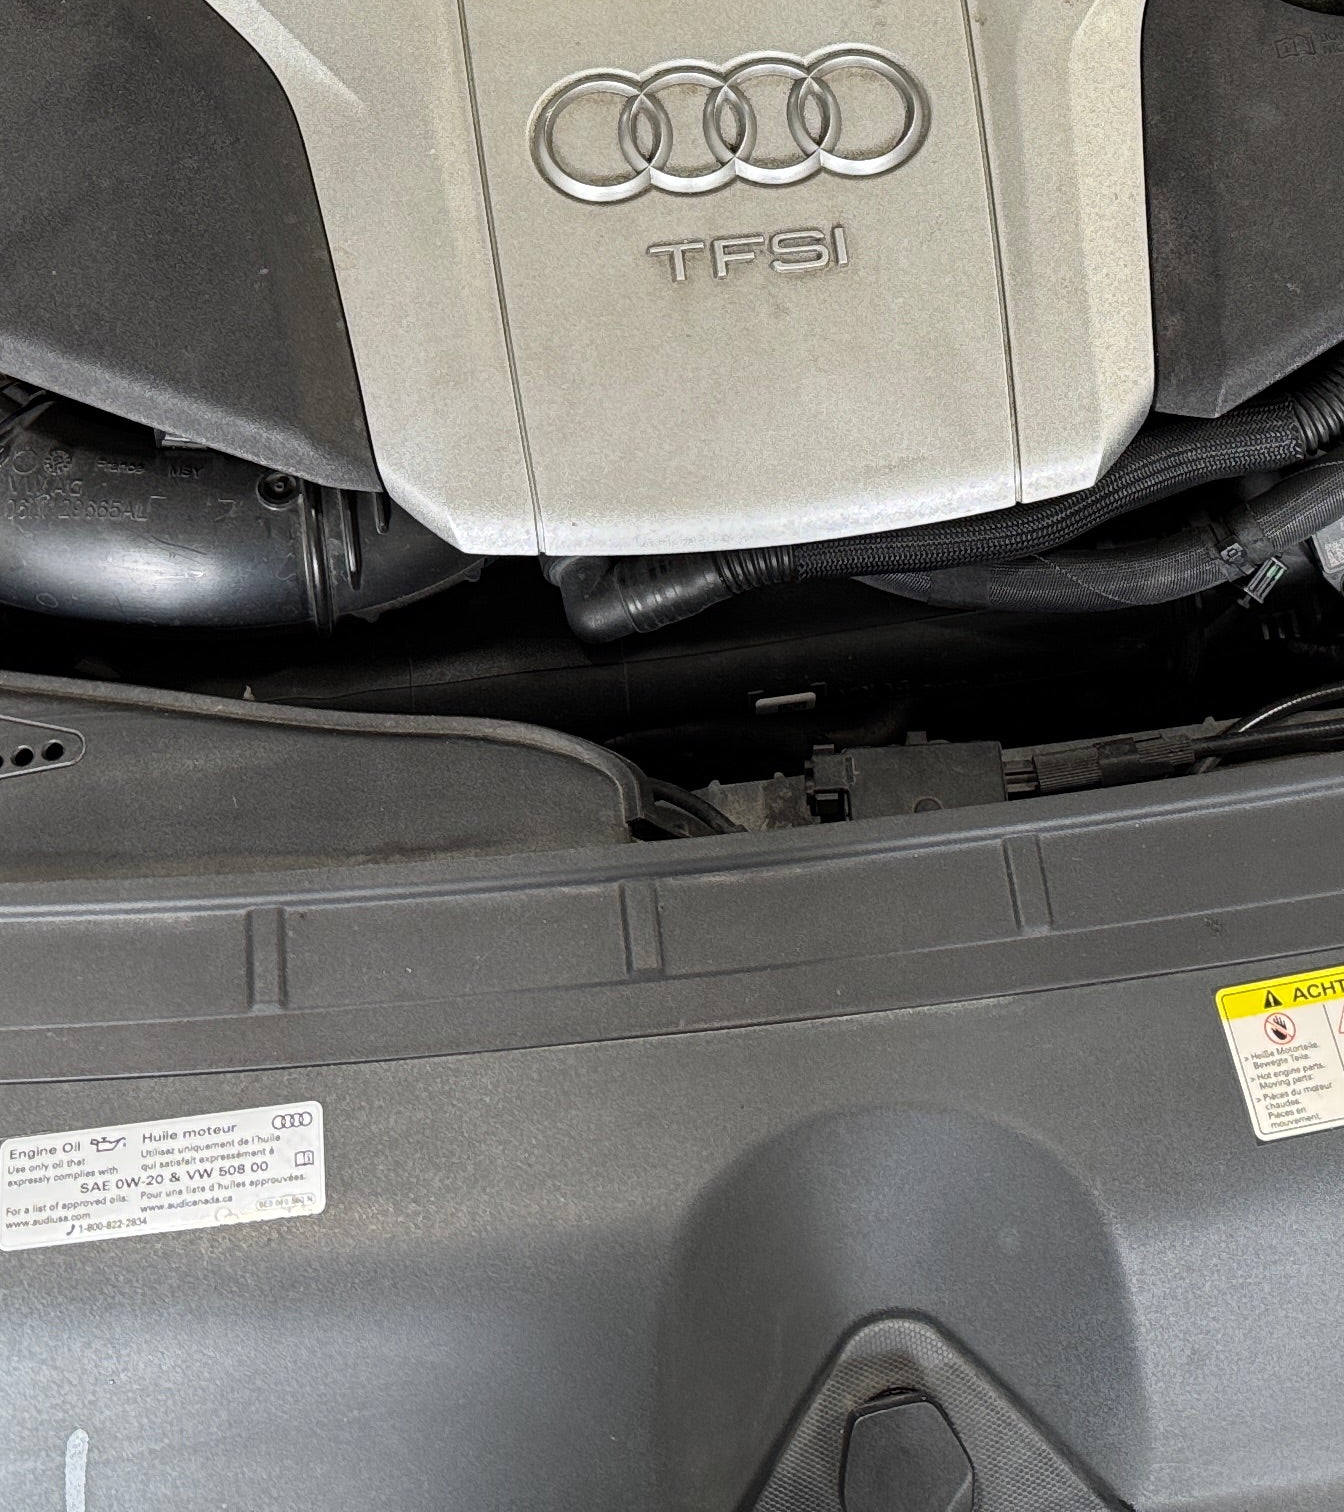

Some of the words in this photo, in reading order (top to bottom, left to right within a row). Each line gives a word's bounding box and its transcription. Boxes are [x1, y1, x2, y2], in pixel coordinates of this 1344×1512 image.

[647, 225, 852, 283] TFSI
[142, 1129, 177, 1143] Huile
[183, 1123, 236, 1138] moteur
[9, 1144, 56, 1162] Engine
[62, 1141, 80, 1153] Oil
[178, 1138, 234, 1155] uniquement
[237, 1136, 248, 1146] de
[7, 1164, 25, 1174] Use
[28, 1162, 48, 1173] only
[52, 1159, 63, 1169] oil
[66, 1157, 85, 1167] that
[141, 1160, 155, 1171] qui
[159, 1156, 195, 1168] satisfait
[7, 1174, 50, 1188] expressly
[53, 1168, 95, 1182] complies
[98, 1165, 118, 1176] with
[80, 1180, 110, 1194] SAE
[115, 1173, 163, 1189] 0W-20
[169, 1171, 180, 1183] &
[186, 1167, 213, 1180] VW
[218, 1163, 245, 1176] 508
[250, 1160, 268, 1173] 00
[140, 1189, 161, 1200] Pour
[165, 1188, 182, 1197] une
[140, 1194, 232, 1213] www.audicanada.ca
[6, 1206, 20, 1216] For
[32, 1203, 46, 1213] list
[49, 1201, 58, 1211] of
[61, 1196, 106, 1211] approved
[5, 1211, 90, 1229] www.audiusa.com
[79, 1216, 147, 1233] 1-800-822-2834
